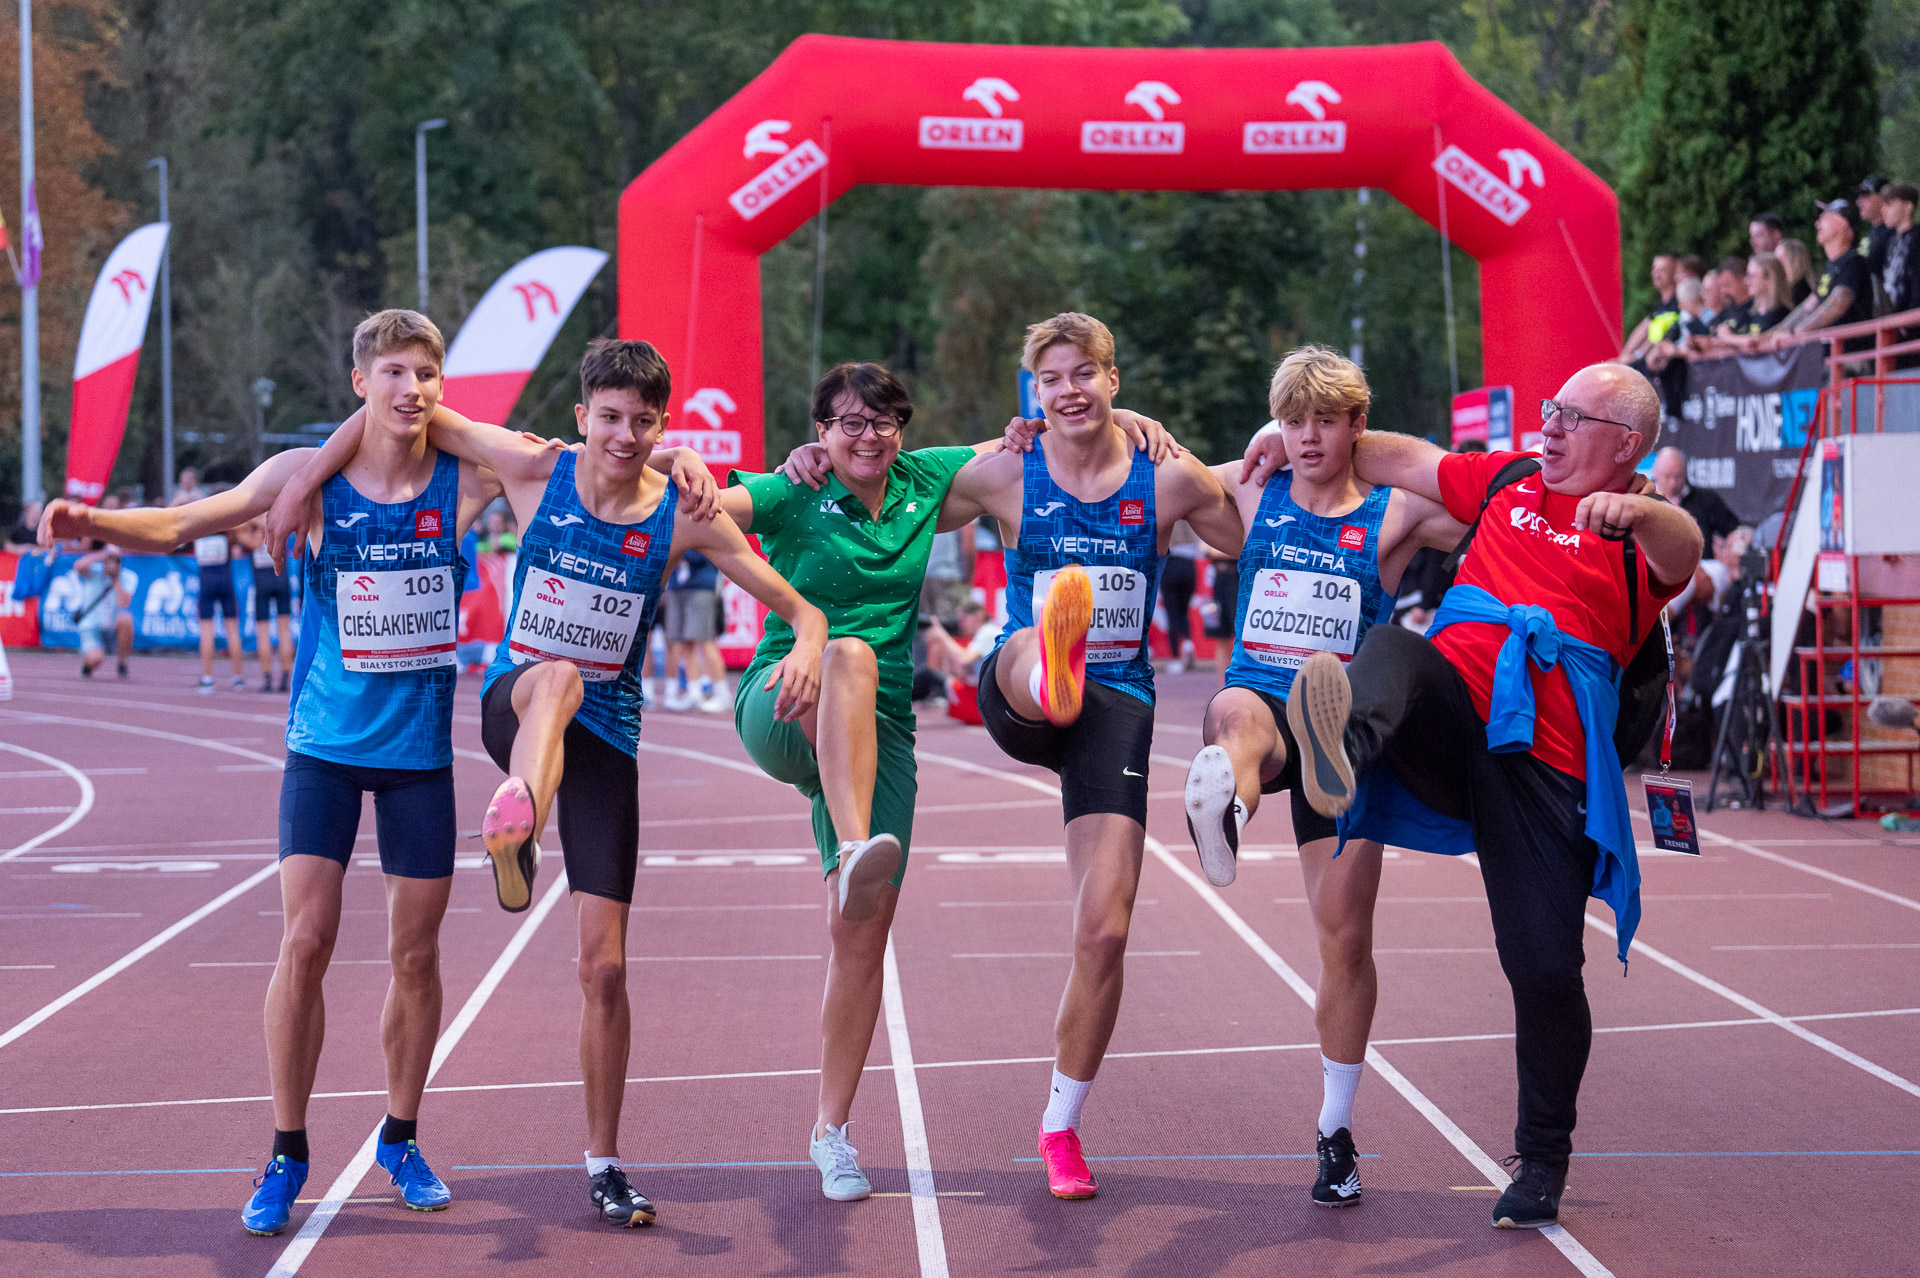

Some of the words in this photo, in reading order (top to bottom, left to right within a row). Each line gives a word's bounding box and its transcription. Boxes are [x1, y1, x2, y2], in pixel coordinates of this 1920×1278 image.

[928, 124, 1013, 143] ORLEN
[1089, 129, 1174, 147] ORLEN
[1251, 129, 1336, 148] ORLEN
[743, 151, 815, 209] ORLEN
[1445, 157, 1518, 214] ORLEN
[356, 541, 440, 561] VECTRA
[1050, 536, 1129, 555] VECTRA
[1271, 541, 1346, 573] VECTRA
[549, 547, 627, 587] VECTRA
[404, 574, 444, 596] 103
[1098, 573, 1136, 592] 105
[1312, 580, 1352, 602] 104
[351, 594, 380, 602] ORLEN
[536, 592, 565, 607] ORLEN
[1264, 590, 1288, 598] ORLEN
[590, 593, 632, 618] 102
[343, 608, 451, 637] CIEŚLAKIEWICZ
[1089, 607, 1140, 629] JEWSKI
[1250, 606, 1352, 641] GOŹDZIECKI
[519, 609, 628, 653] BAJRASZEWSKI
[360, 660, 414, 669] BIAŁYSTOK
[415, 657, 439, 667] 2024
[1101, 651, 1122, 660] 2024
[579, 670, 602, 680] 2024
[1664, 839, 1690, 849] TRENER
